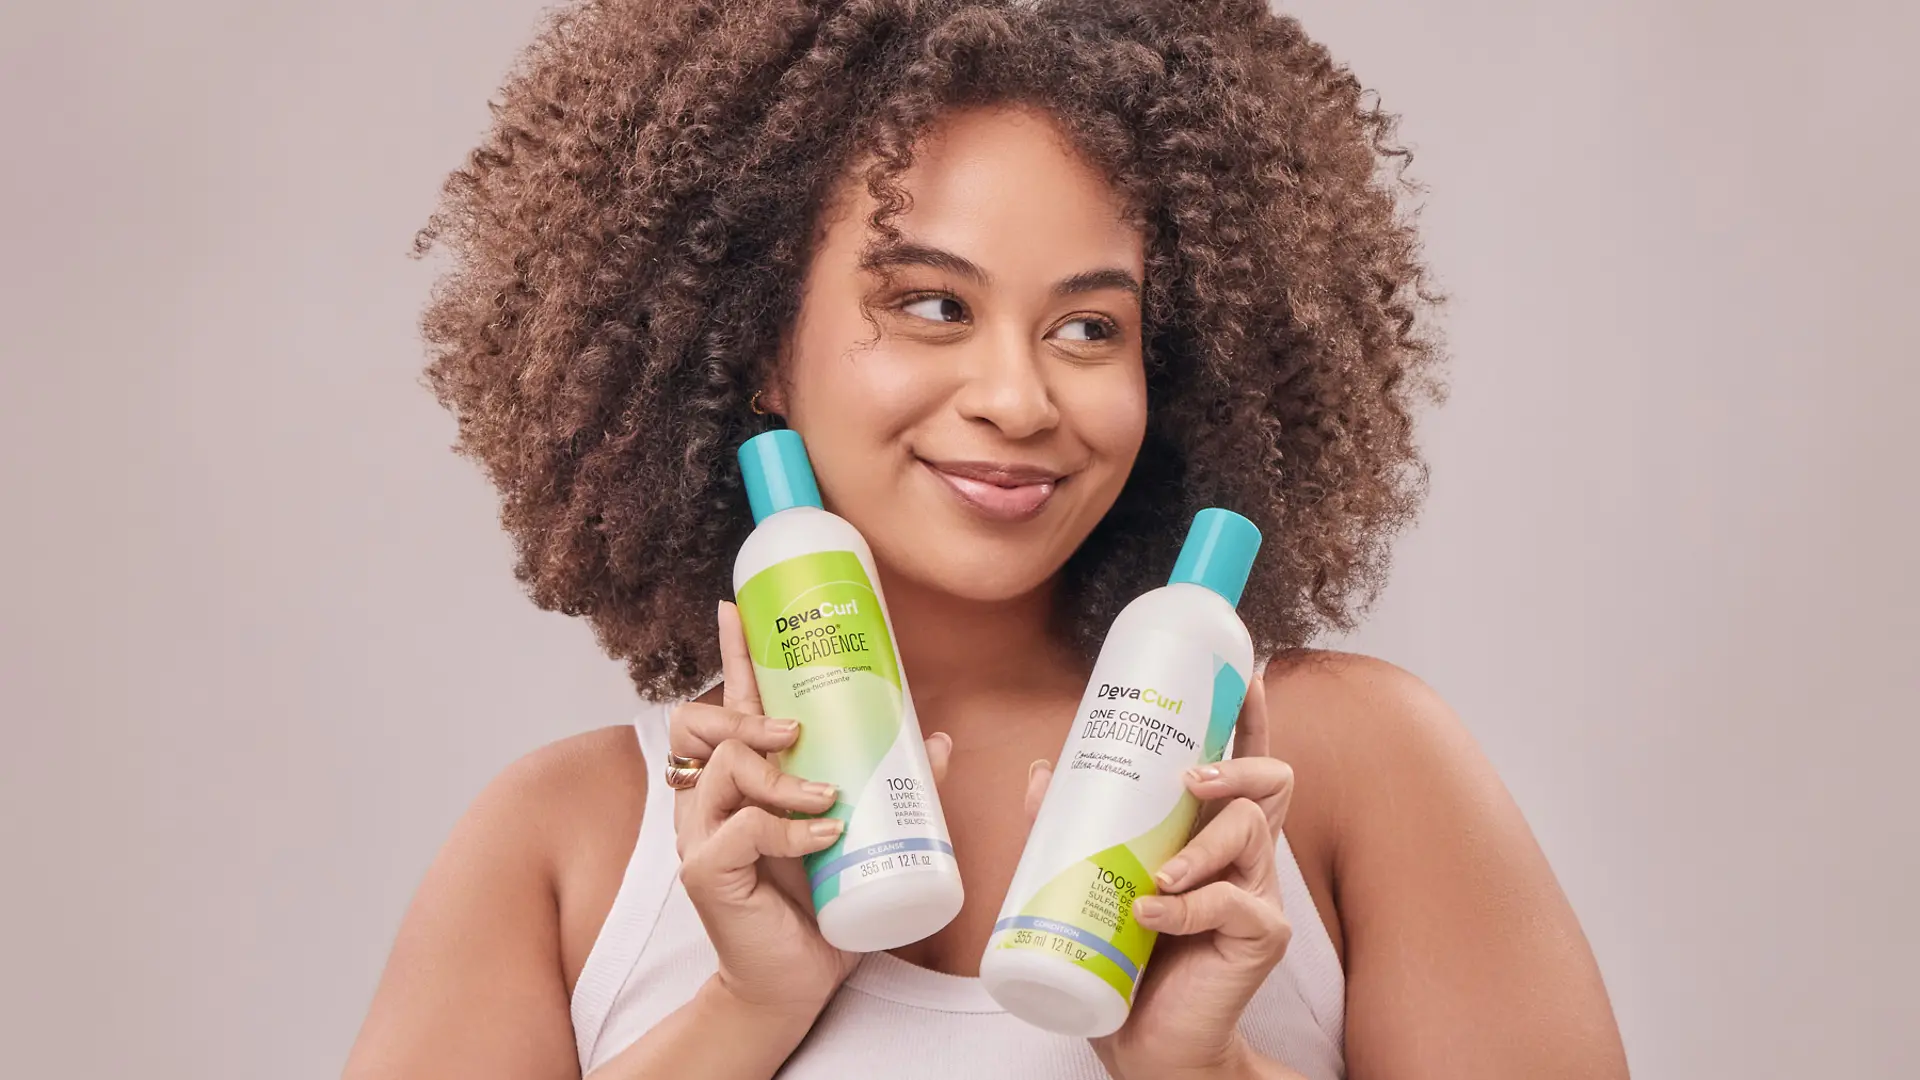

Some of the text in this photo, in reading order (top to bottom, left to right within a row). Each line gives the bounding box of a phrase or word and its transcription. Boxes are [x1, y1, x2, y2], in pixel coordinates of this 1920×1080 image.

[775, 599, 859, 633] DevaCurl
[784, 633, 869, 671] DECADENCE
[792, 665, 872, 690] Shampoo sem Espuma
[1097, 684, 1183, 714] DevaCurl
[1089, 709, 1116, 719] ONE
[1081, 720, 1168, 755] DECADENCE
[890, 793, 915, 801] LIVRE
[860, 861, 879, 877] 355
[881, 857, 894, 869] ml
[897, 854, 911, 868] 12
[921, 855, 932, 866] oz
[1091, 881, 1133, 908] LIVRE DE
[1096, 867, 1137, 898] 100%
[1084, 900, 1125, 925] PARABENOS
[1088, 891, 1129, 917] SULFATOS
[1033, 919, 1080, 938] CONDITION
[1081, 907, 1123, 934] E SILICONE
[1014, 930, 1032, 944] 355
[1033, 934, 1047, 947] ml
[1051, 937, 1063, 952] 12
[1075, 949, 1087, 962] oz
